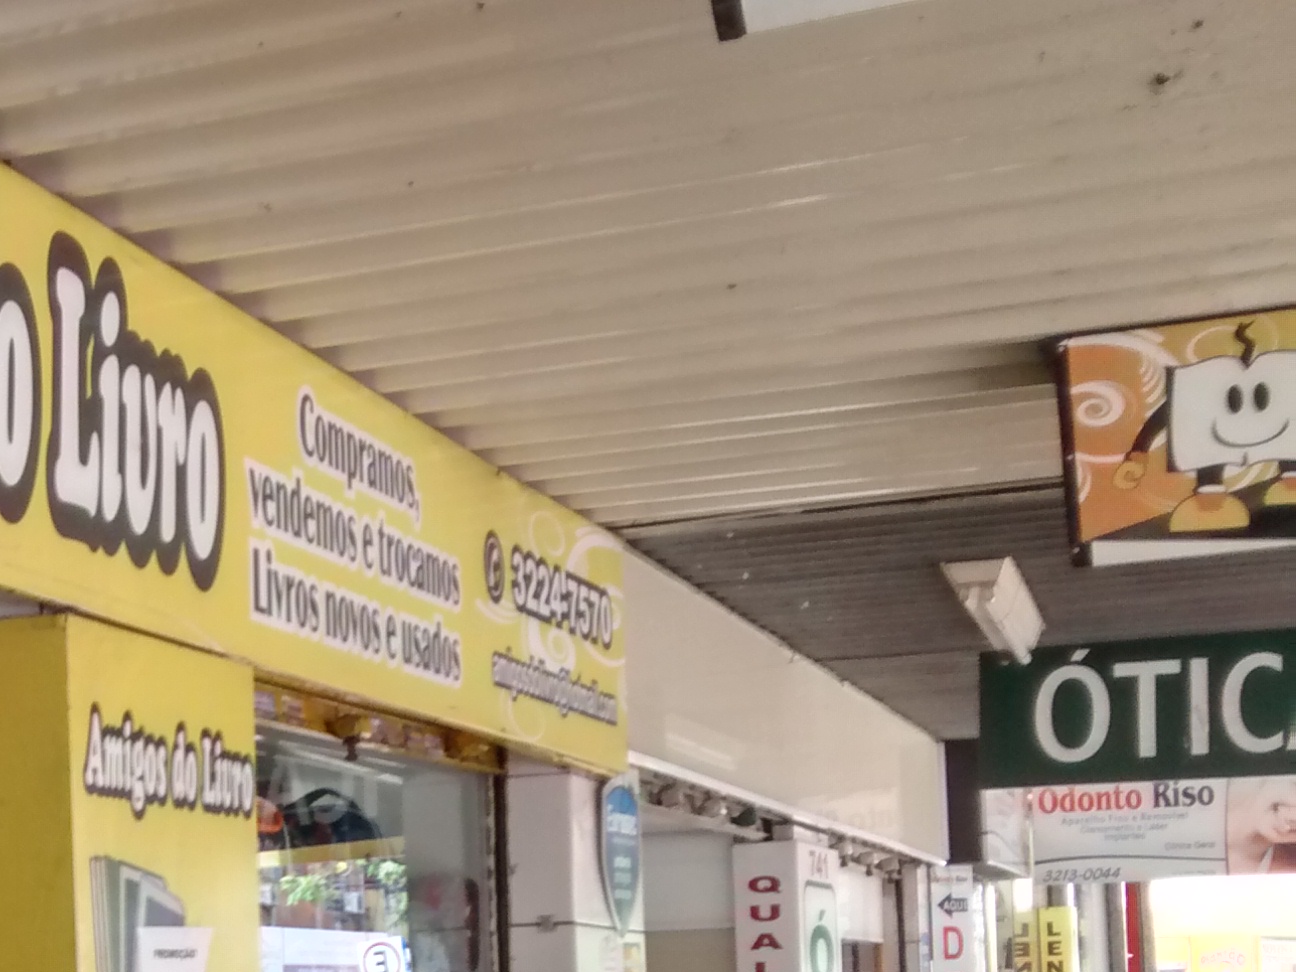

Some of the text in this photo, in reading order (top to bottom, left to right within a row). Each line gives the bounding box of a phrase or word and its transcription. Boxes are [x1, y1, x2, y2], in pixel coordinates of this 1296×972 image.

[50, 252, 225, 580] Livro
[299, 392, 420, 522] Compramos,
[248, 466, 461, 606] vendemos e trocamos
[252, 546, 461, 682] Livros novos e usados
[512, 546, 613, 650] 3224-7570
[83, 703, 253, 818] Amigos do Livro
[1035, 648, 1296, 764] ÓTIC
[1037, 780, 1216, 815] Odonto Riso
[809, 850, 829, 880] 741
[1043, 867, 1122, 883] 3213-0044
